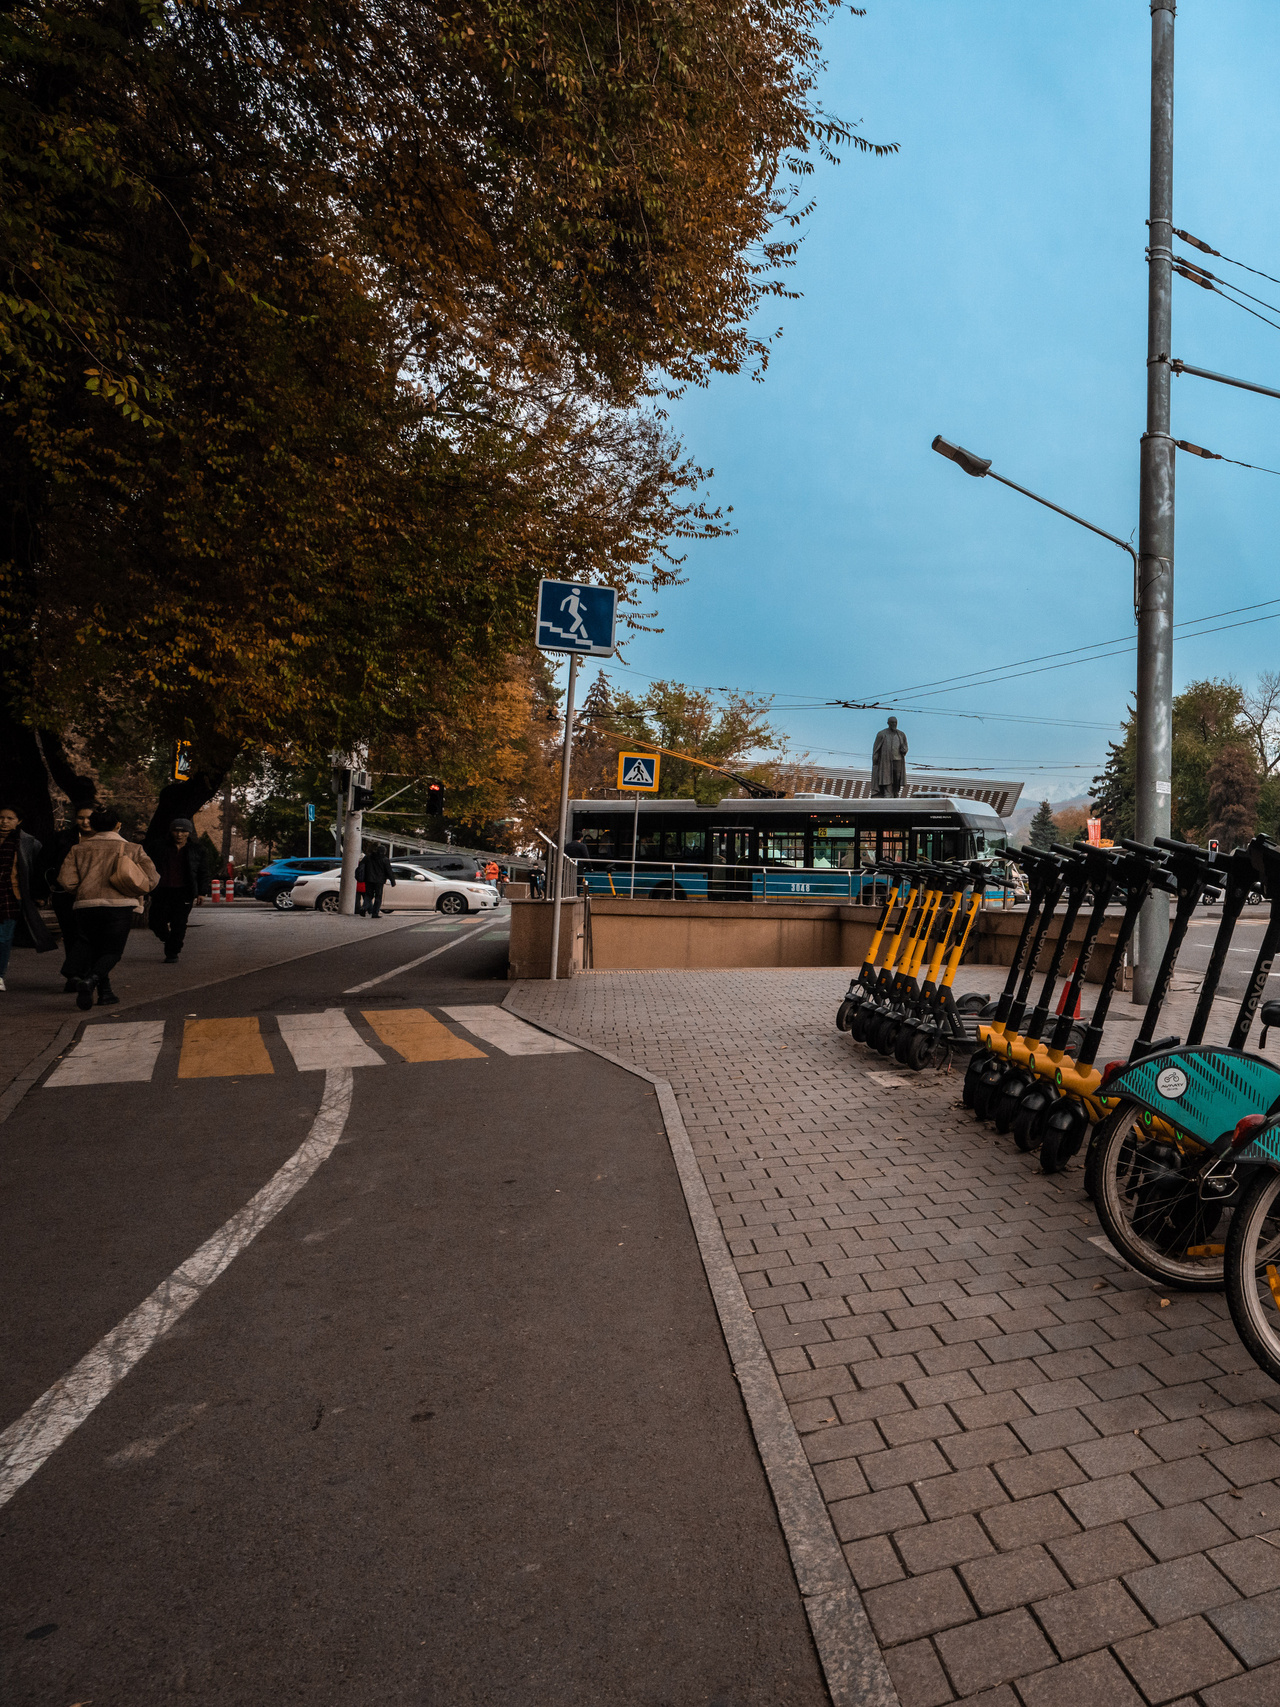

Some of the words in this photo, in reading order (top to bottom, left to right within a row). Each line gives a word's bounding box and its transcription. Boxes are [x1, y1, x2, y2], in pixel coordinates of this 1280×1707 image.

[1029, 929, 1049, 977] eleven
[1078, 934, 1098, 988] eleven
[1240, 959, 1273, 1034] eleven
